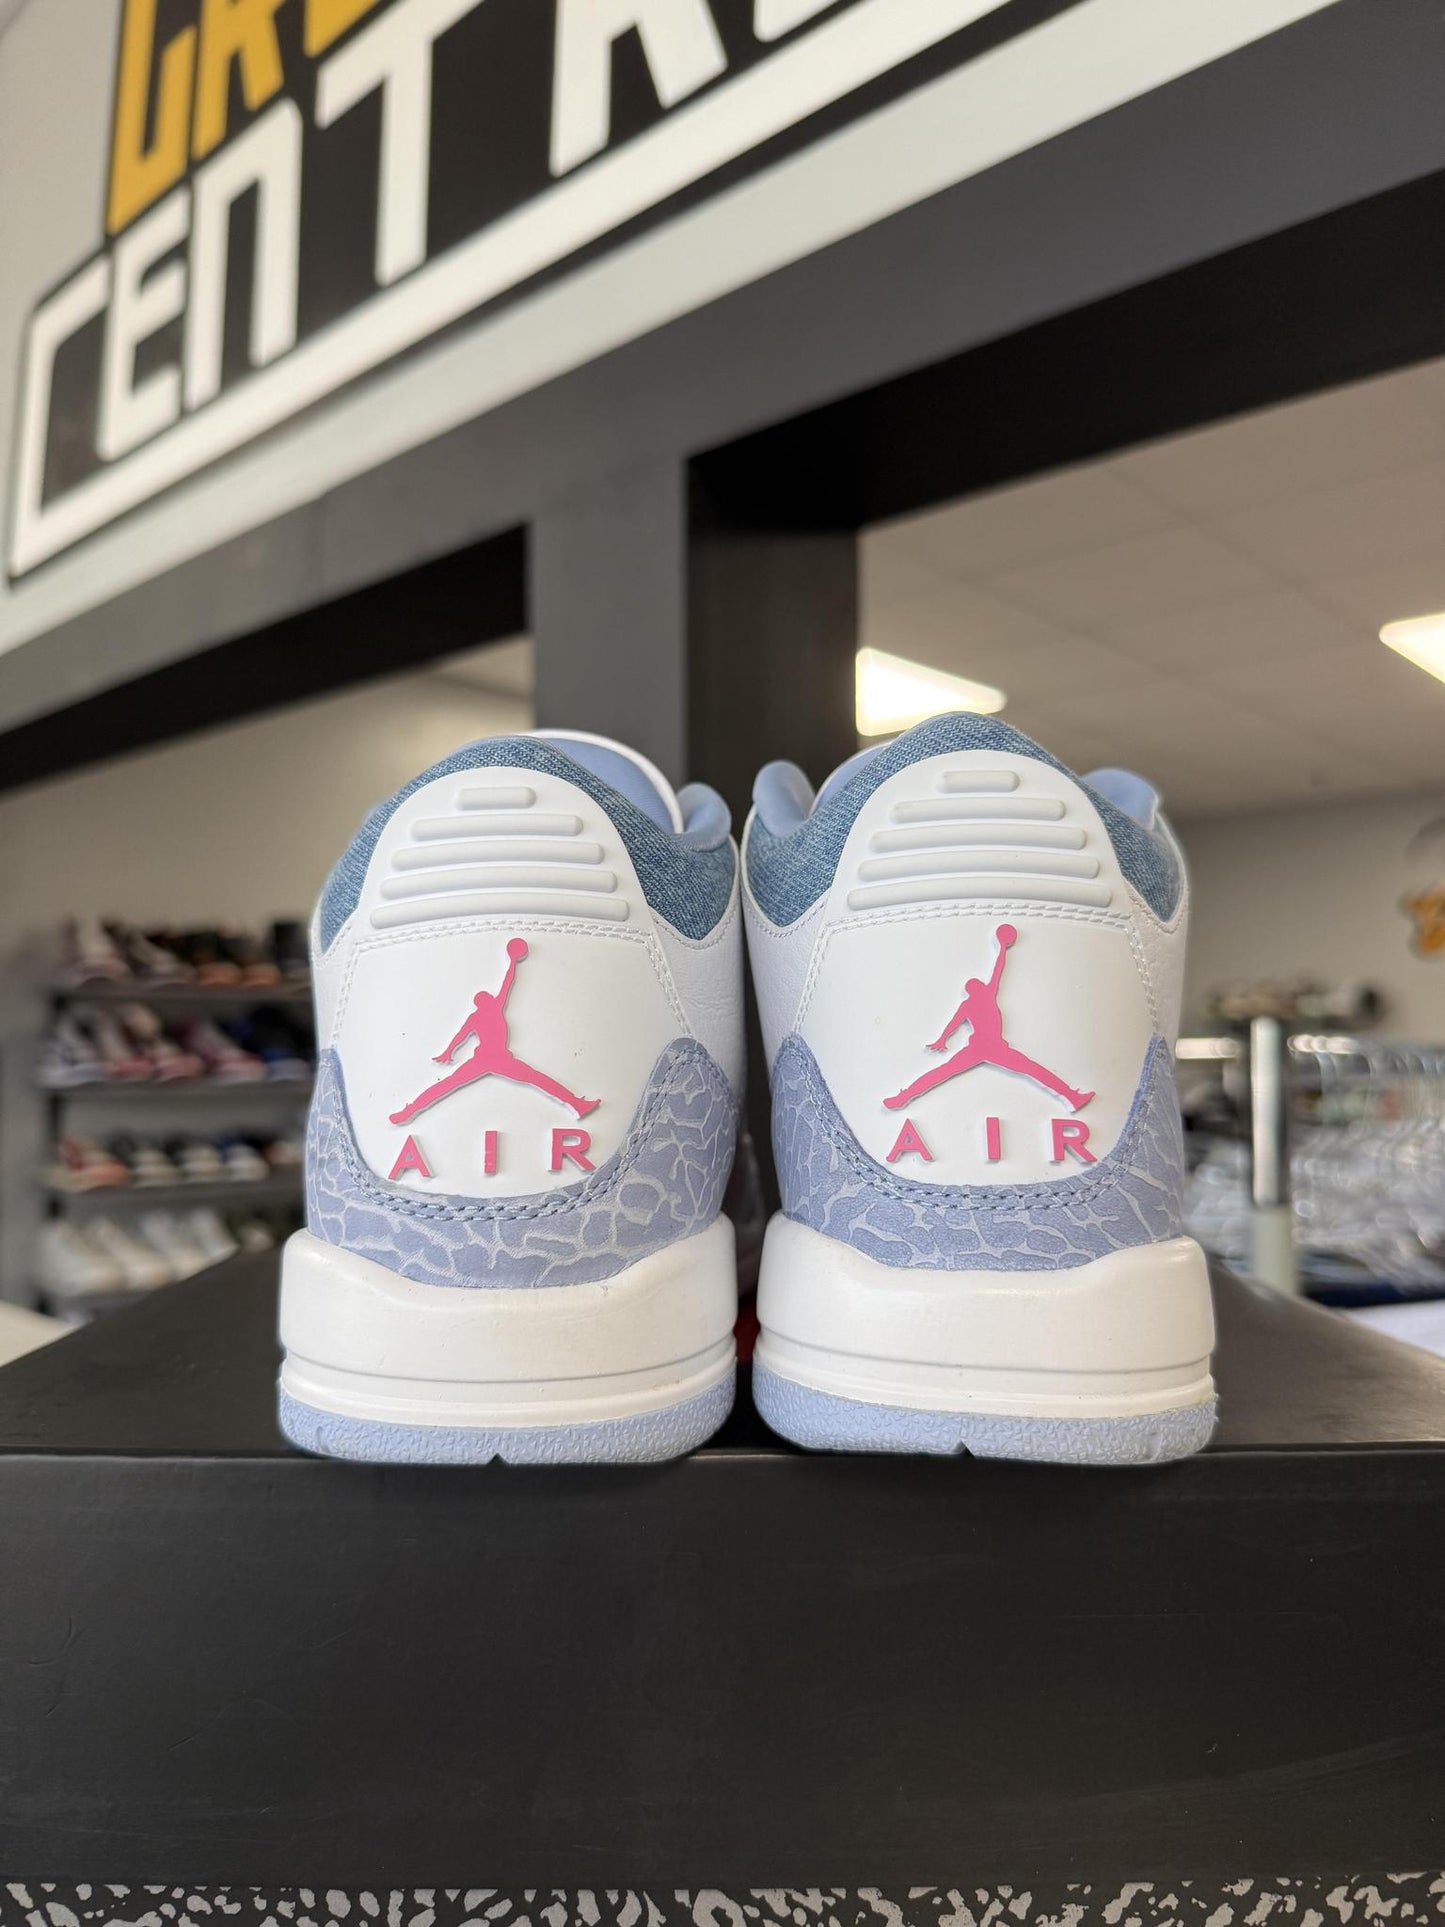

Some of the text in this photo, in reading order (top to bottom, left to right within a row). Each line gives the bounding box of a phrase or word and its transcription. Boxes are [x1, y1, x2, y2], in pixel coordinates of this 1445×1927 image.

[105, 0, 381, 237] CR
[387, 1128, 598, 1181] AIR
[886, 1117, 1098, 1163] AIR
